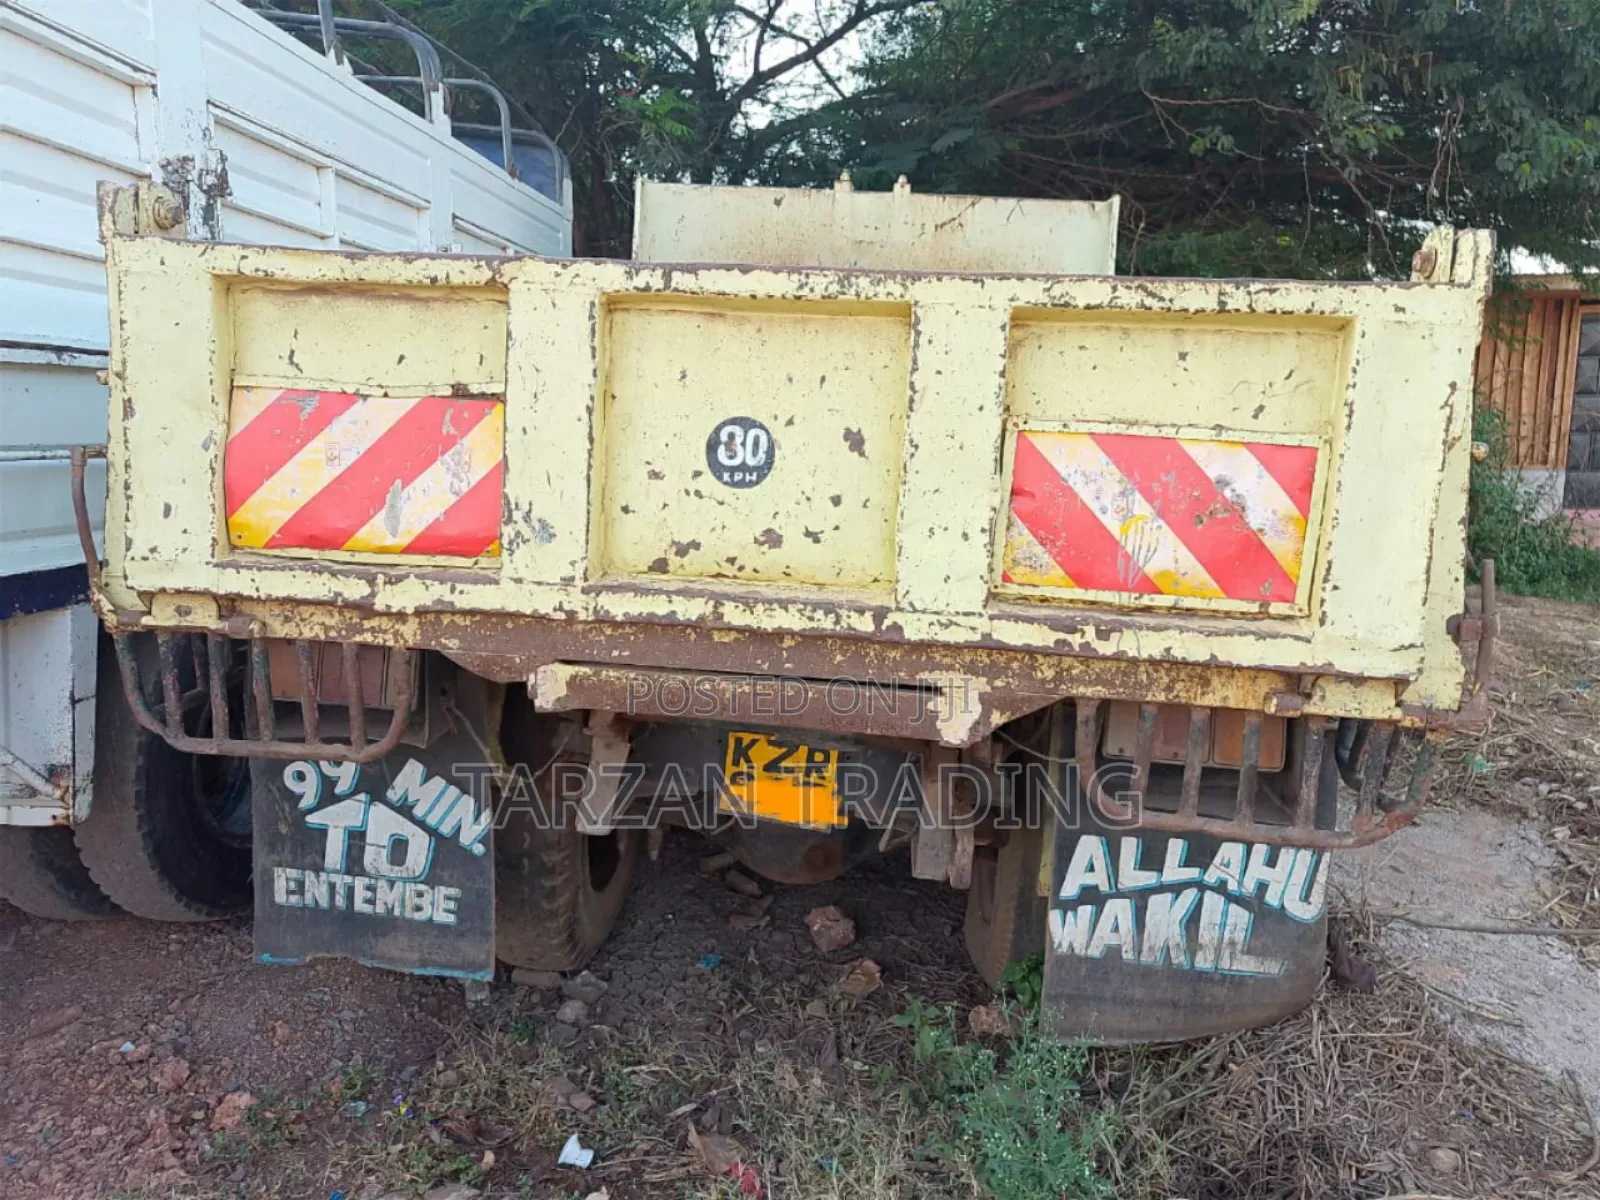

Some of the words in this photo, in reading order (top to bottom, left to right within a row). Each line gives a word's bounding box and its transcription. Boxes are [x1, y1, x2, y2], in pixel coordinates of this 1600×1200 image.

[717, 425, 769, 467] 80
[723, 471, 758, 483] KPH
[731, 735, 832, 781] KZR
[304, 792, 436, 882] TO
[273, 866, 462, 926] ENTEMBE
[1058, 834, 1331, 924] ALLAHU
[1047, 887, 1288, 977] WAKIL
